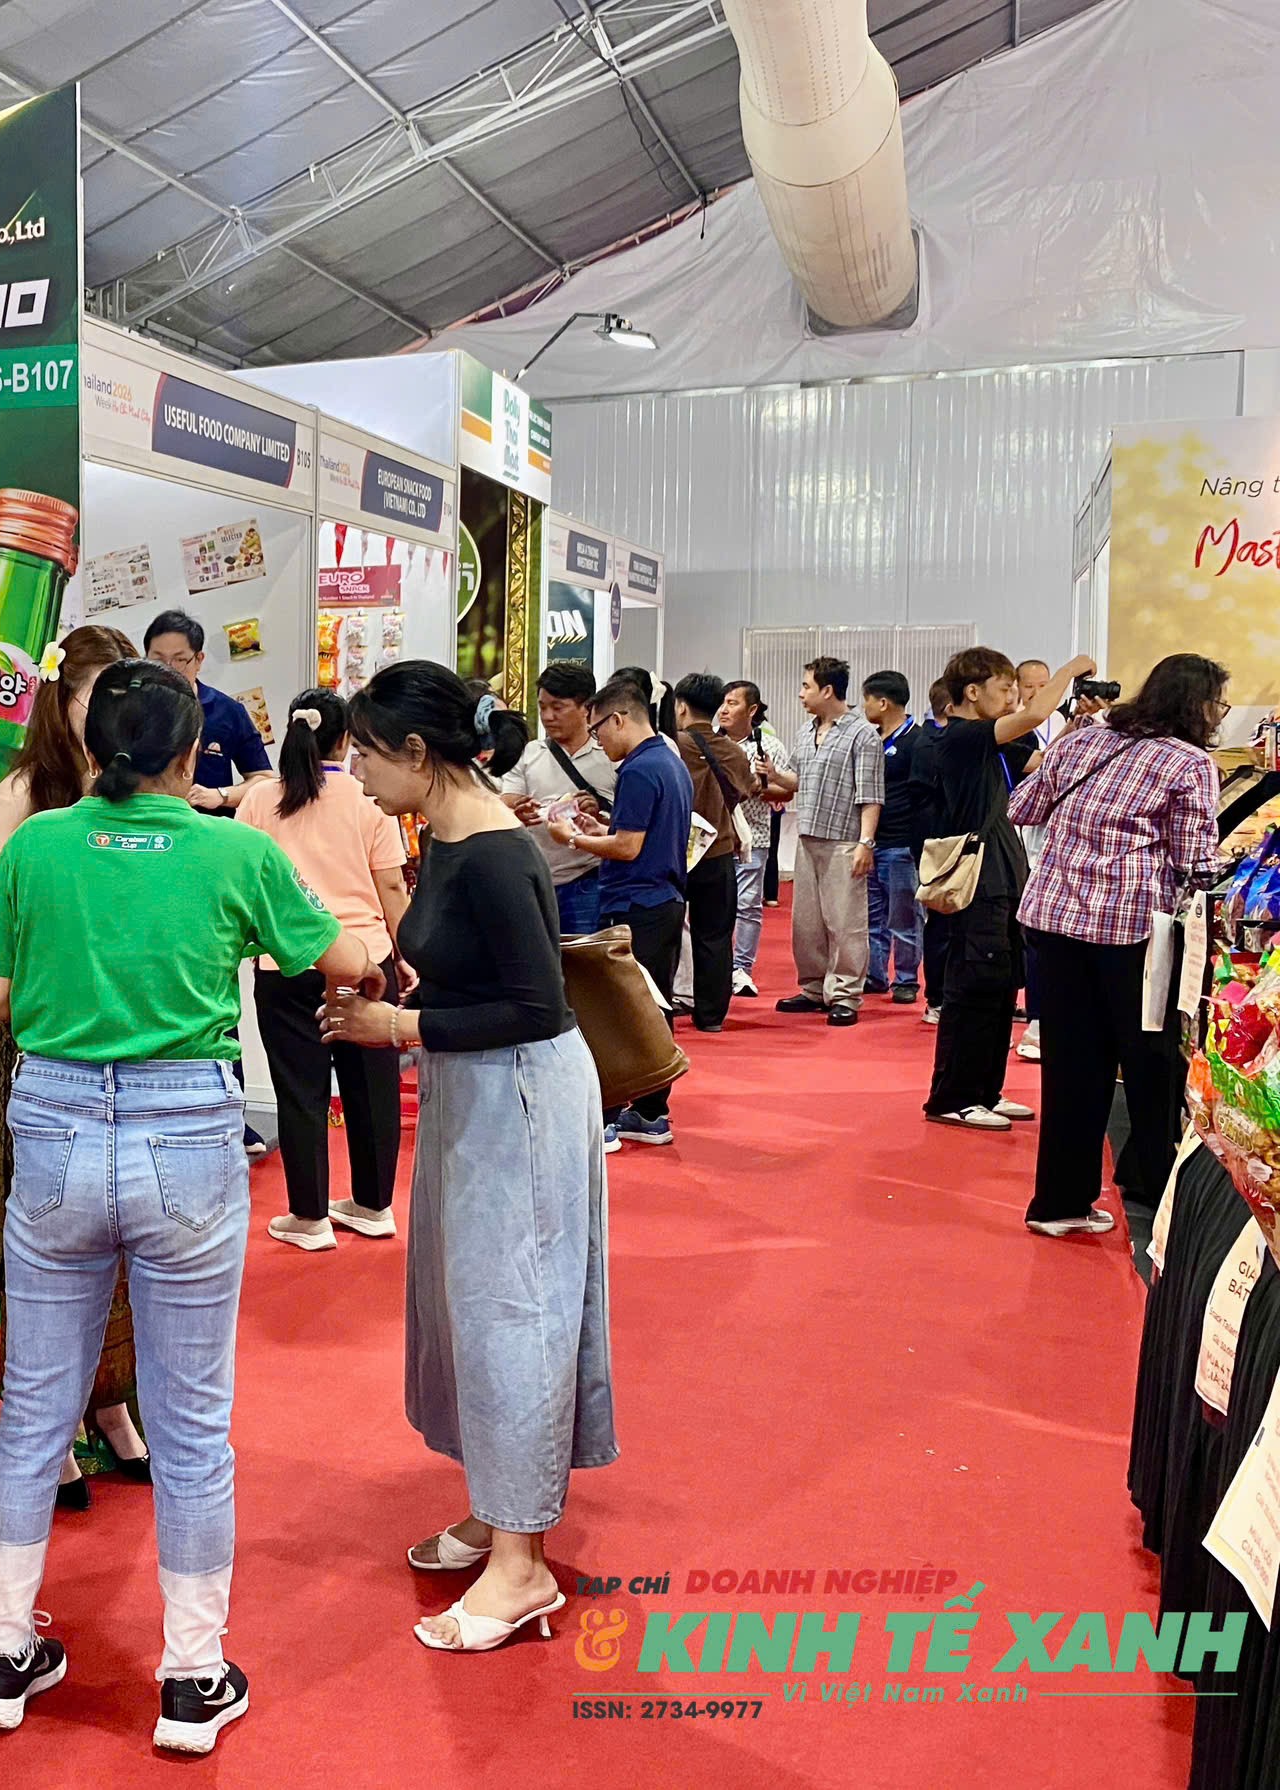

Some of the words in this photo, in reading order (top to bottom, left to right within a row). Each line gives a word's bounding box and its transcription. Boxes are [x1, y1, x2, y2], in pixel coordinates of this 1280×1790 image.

[164, 404, 198, 434] USEFUL
[198, 415, 222, 442] FOOD
[223, 424, 262, 453] COMPANY
[262, 437, 290, 463] LIMITED
[377, 468, 403, 492] EUROPEAN
[404, 478, 419, 498] SNACK
[419, 484, 432, 502] FOOD
[1200, 477, 1264, 498] Nâng
[319, 571, 364, 587] EURO
[338, 584, 369, 594] SNACK
